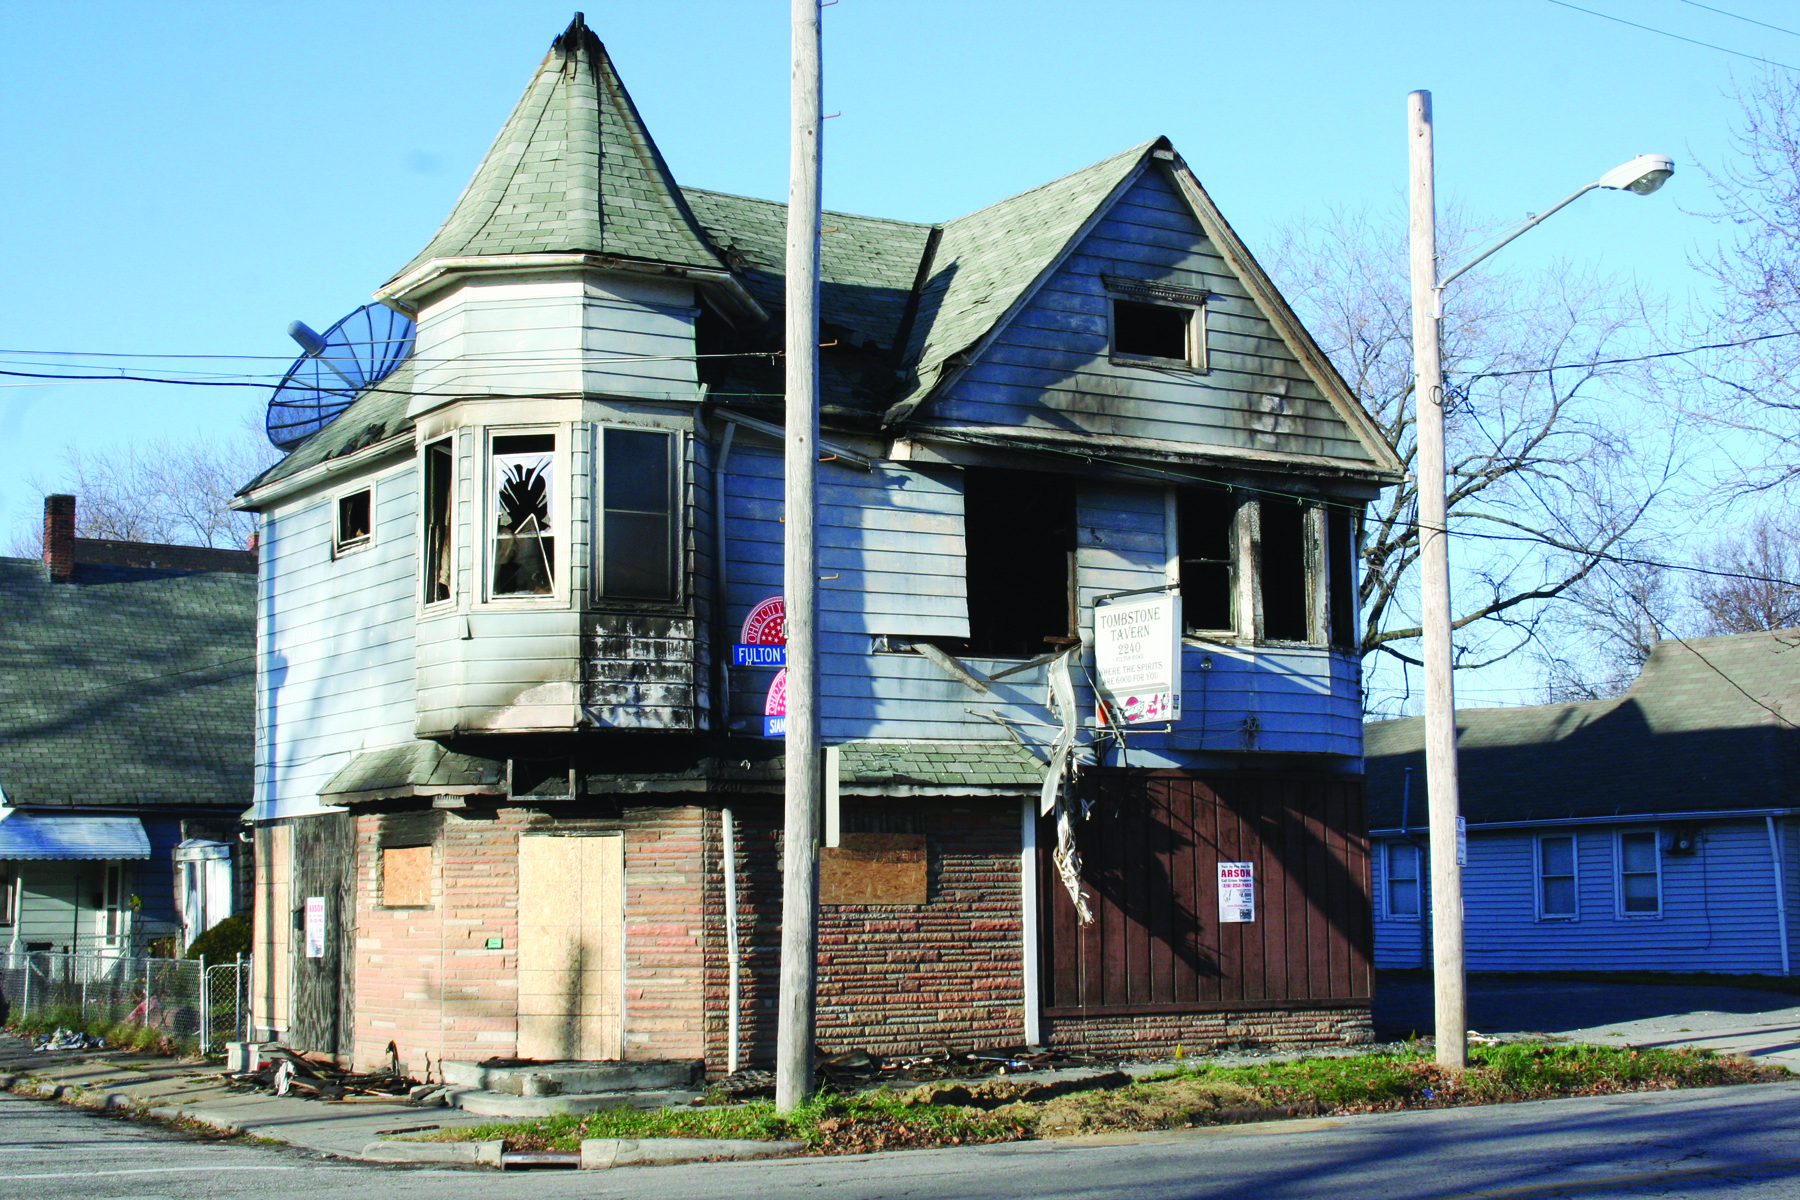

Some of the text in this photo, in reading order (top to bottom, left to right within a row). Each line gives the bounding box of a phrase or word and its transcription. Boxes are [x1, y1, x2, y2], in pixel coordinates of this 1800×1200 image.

[748, 602, 782, 642] OHIO CITY
[1100, 606, 1160, 629] TOMBSTONE
[1111, 625, 1150, 641] TAVERN
[738, 647, 781, 662] FULTON
[1118, 642, 1141, 655] 2240
[1099, 661, 1163, 677] WHERE THE SPIRITS
[1102, 677, 1114, 686] ARE
[1133, 673, 1145, 682] FOR
[1146, 671, 1159, 680] YOU
[769, 687, 779, 713] OHIO
[1221, 869, 1251, 877] ARSON
[309, 904, 323, 912] ARSON
